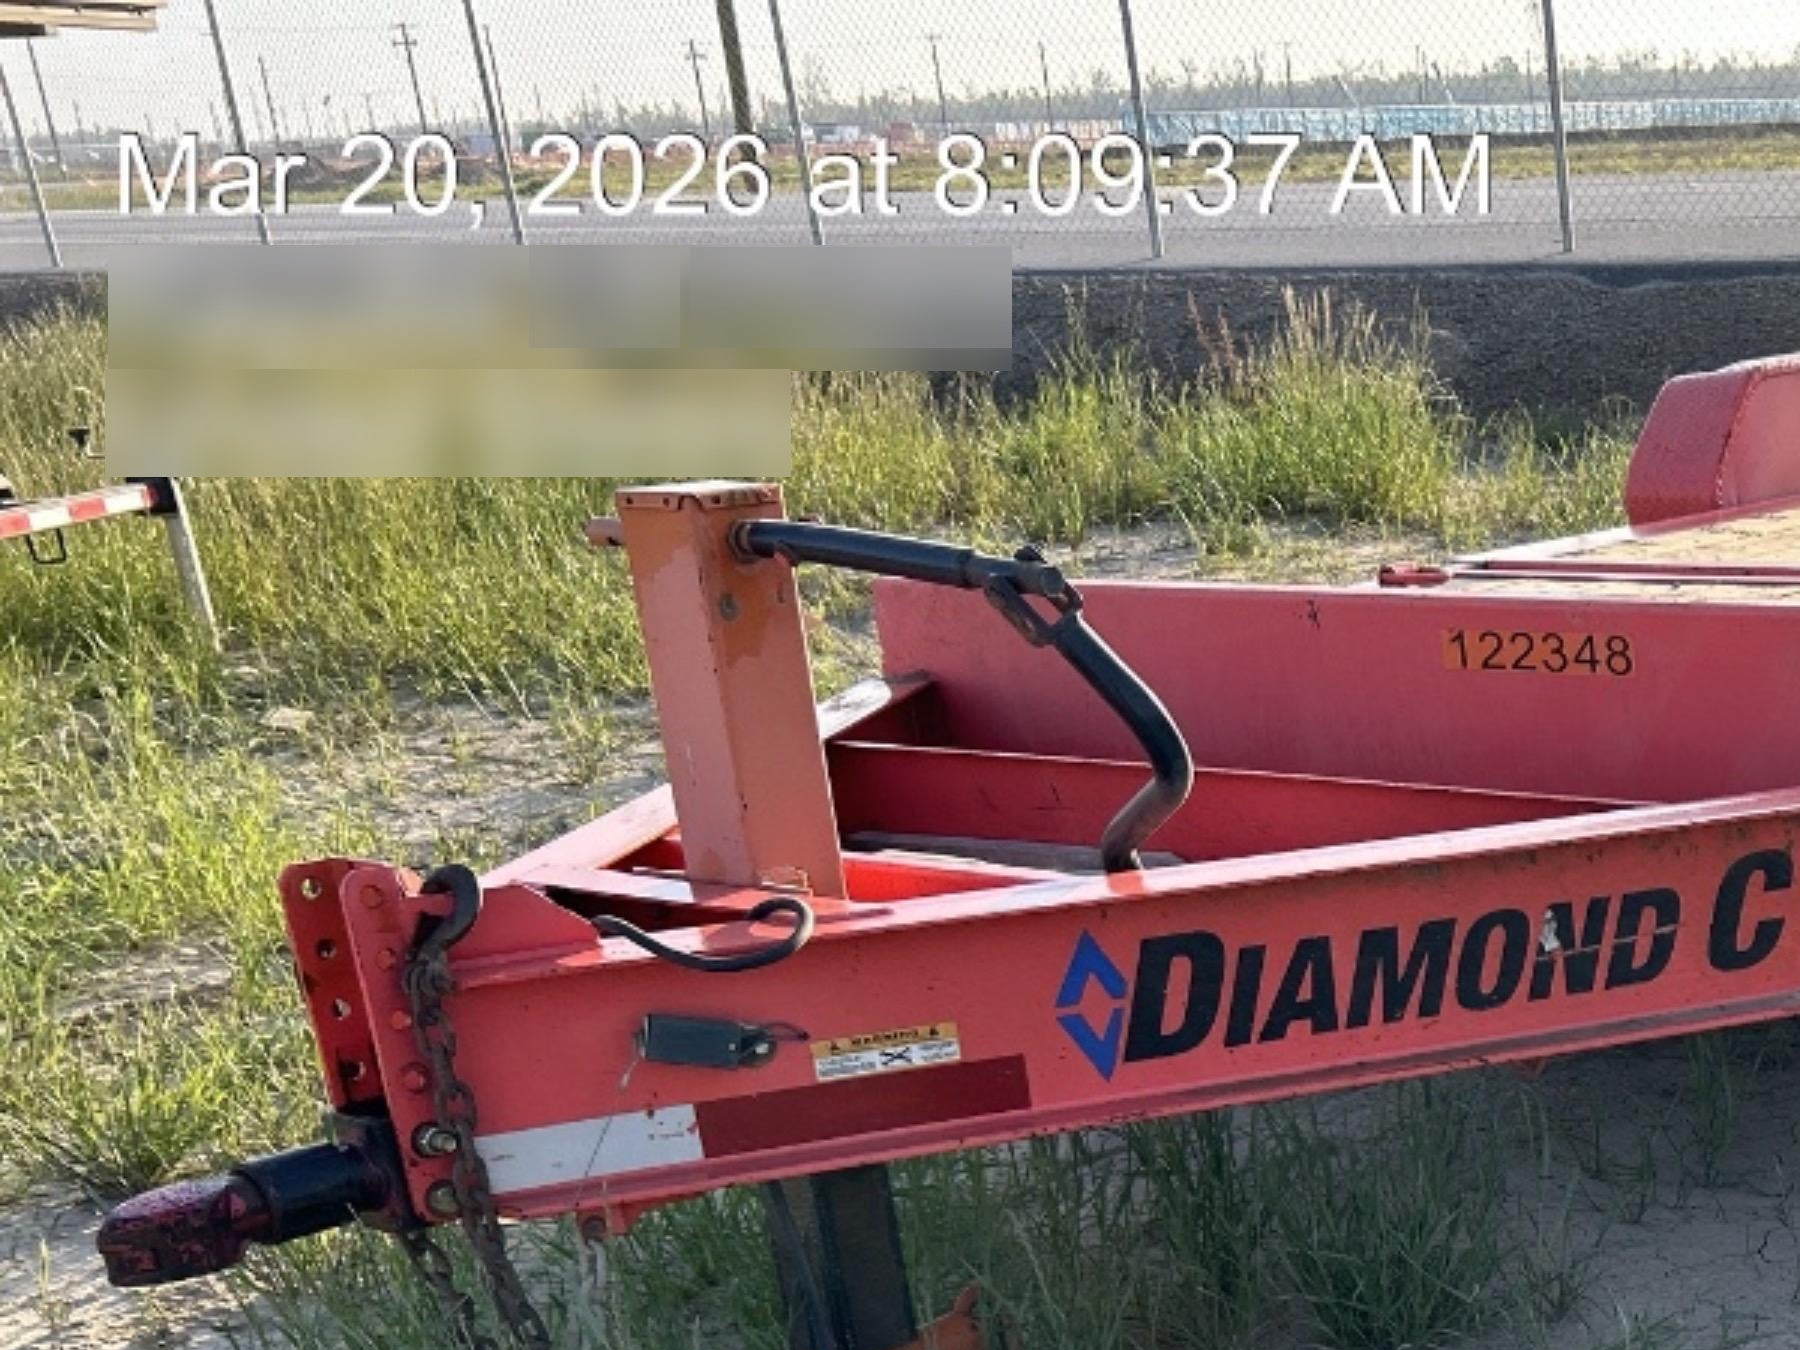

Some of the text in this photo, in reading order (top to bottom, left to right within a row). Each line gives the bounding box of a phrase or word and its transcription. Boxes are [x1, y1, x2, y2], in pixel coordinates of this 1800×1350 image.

[1449, 629, 1633, 676] 122348
[1124, 848, 1794, 1063] DIAMOND C
